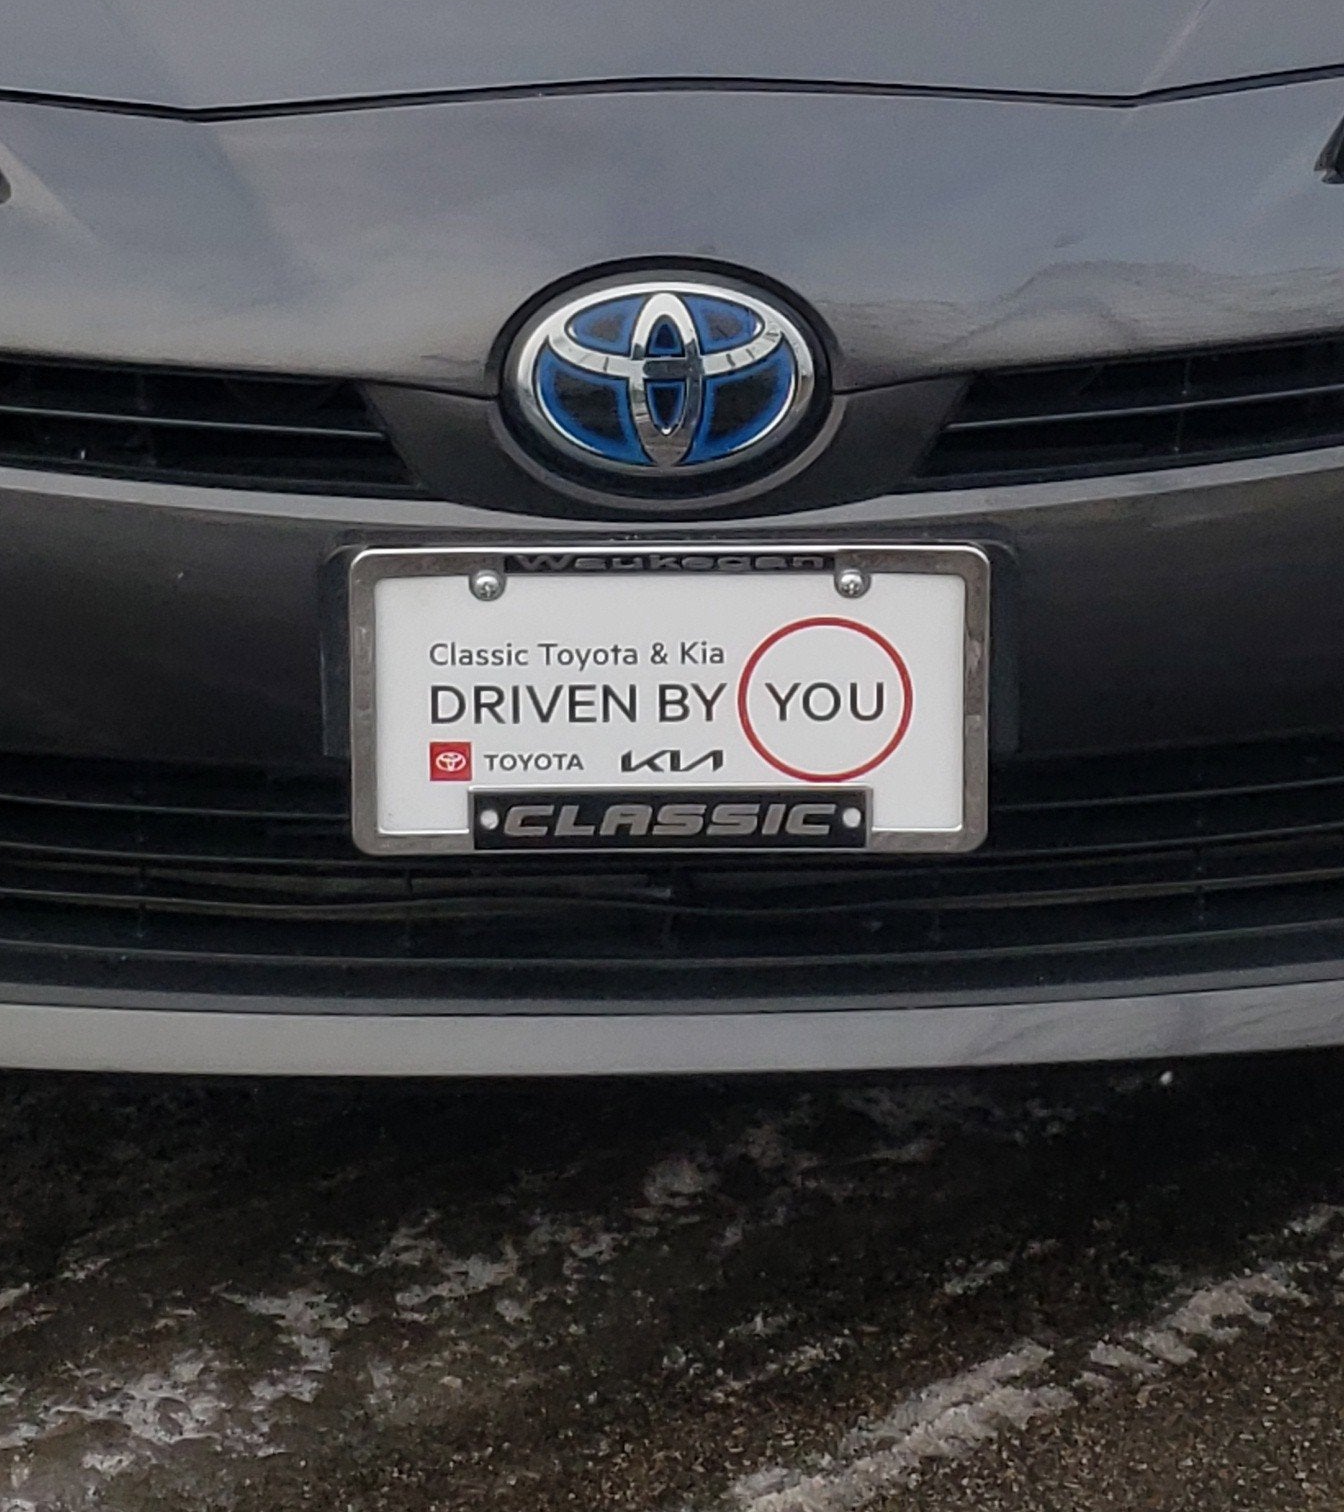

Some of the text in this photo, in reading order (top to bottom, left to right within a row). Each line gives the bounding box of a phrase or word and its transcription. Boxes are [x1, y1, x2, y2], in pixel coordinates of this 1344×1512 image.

[429, 641, 725, 671] Classic Toyota & Kia
[430, 681, 885, 724] DRIVEN BY YOU
[484, 753, 584, 772] TOYOTA
[502, 803, 838, 837] CLASSIC
